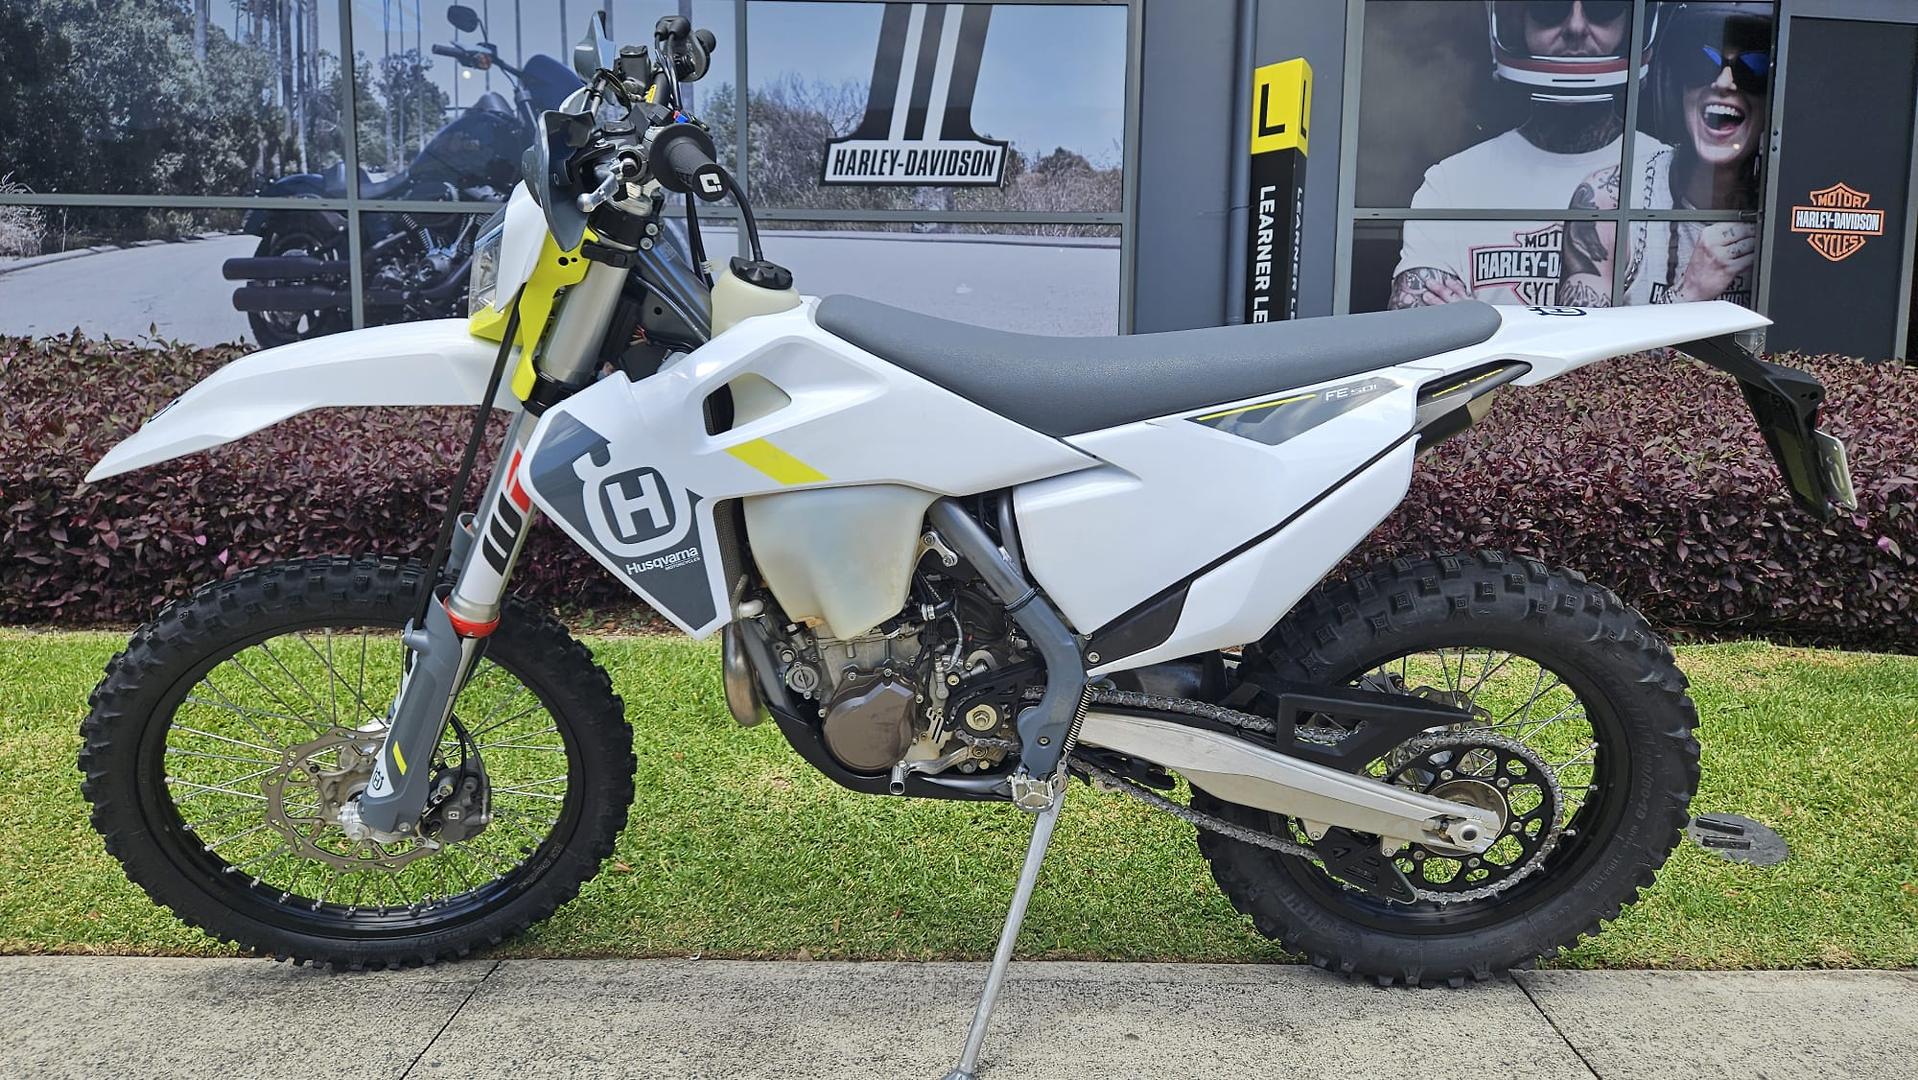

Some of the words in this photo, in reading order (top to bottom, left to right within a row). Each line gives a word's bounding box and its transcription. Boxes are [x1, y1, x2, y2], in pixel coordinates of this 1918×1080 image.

[1258, 83, 1286, 138] L
[832, 149, 997, 177] HARLEY-DAVIDSON
[1817, 187, 1862, 208] MOTOR
[1795, 210, 1880, 231] HARLEY-DAVIDSON
[1254, 184, 1276, 291] LEARNER
[1814, 233, 1859, 258] CYCLES
[1477, 251, 1560, 280] HARLEY-D
[1325, 387, 1349, 401] FE
[625, 547, 699, 575] Husqvarna
